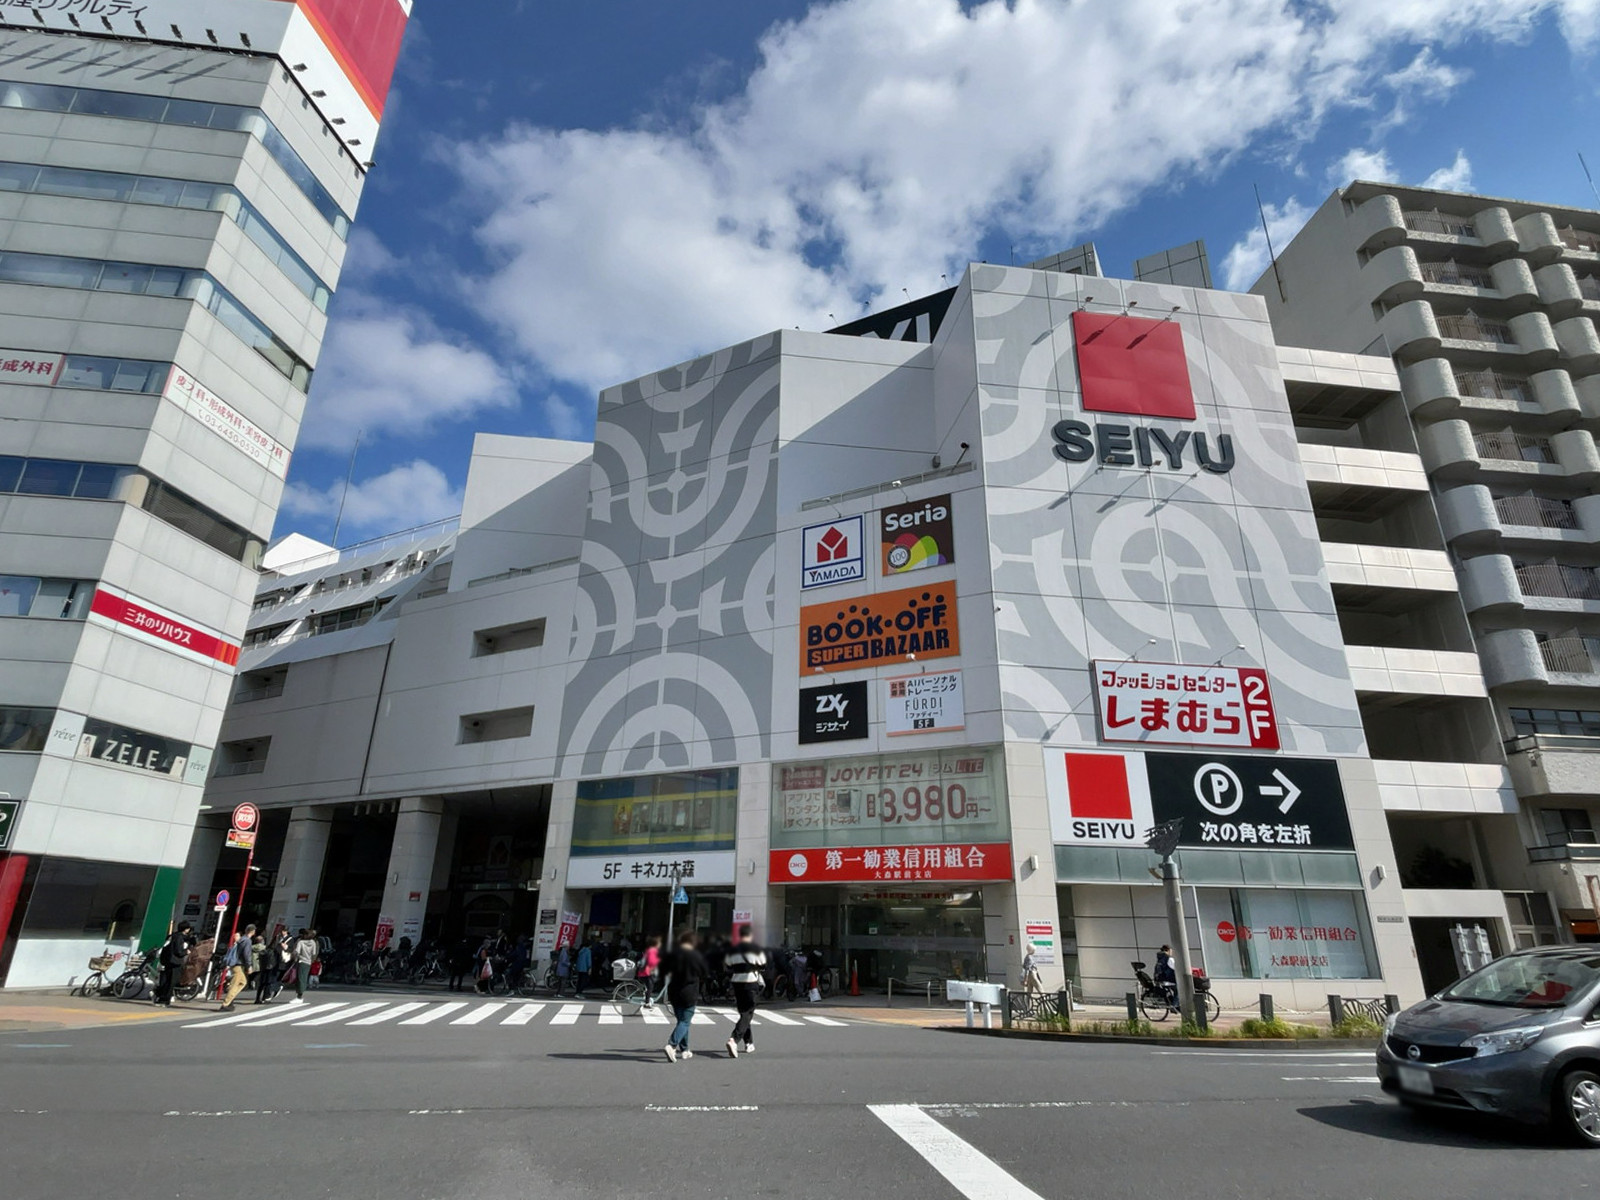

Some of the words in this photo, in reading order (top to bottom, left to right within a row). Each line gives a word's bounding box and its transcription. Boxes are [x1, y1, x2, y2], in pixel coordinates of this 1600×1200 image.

[1052, 420, 1236, 473] SEIYU
[885, 504, 948, 532] Seria
[809, 565, 857, 583] YAMADA
[124, 608, 192, 645] 三井のリハウス
[811, 645, 865, 665] SUPER
[870, 629, 950, 659] BAZAAR
[907, 683, 957, 697] トレーニング
[1102, 670, 1237, 693] ファッションセンター
[816, 693, 850, 719] ZXY
[1106, 694, 1242, 735] しまむら
[1243, 675, 1271, 740] 2F
[101, 739, 160, 770] ZELE
[1073, 821, 1135, 840] SEIYU
[1200, 821, 1312, 846] 次の角を左折
[603, 862, 622, 879] 5F
[825, 846, 986, 870] 第一勧業信用組合
